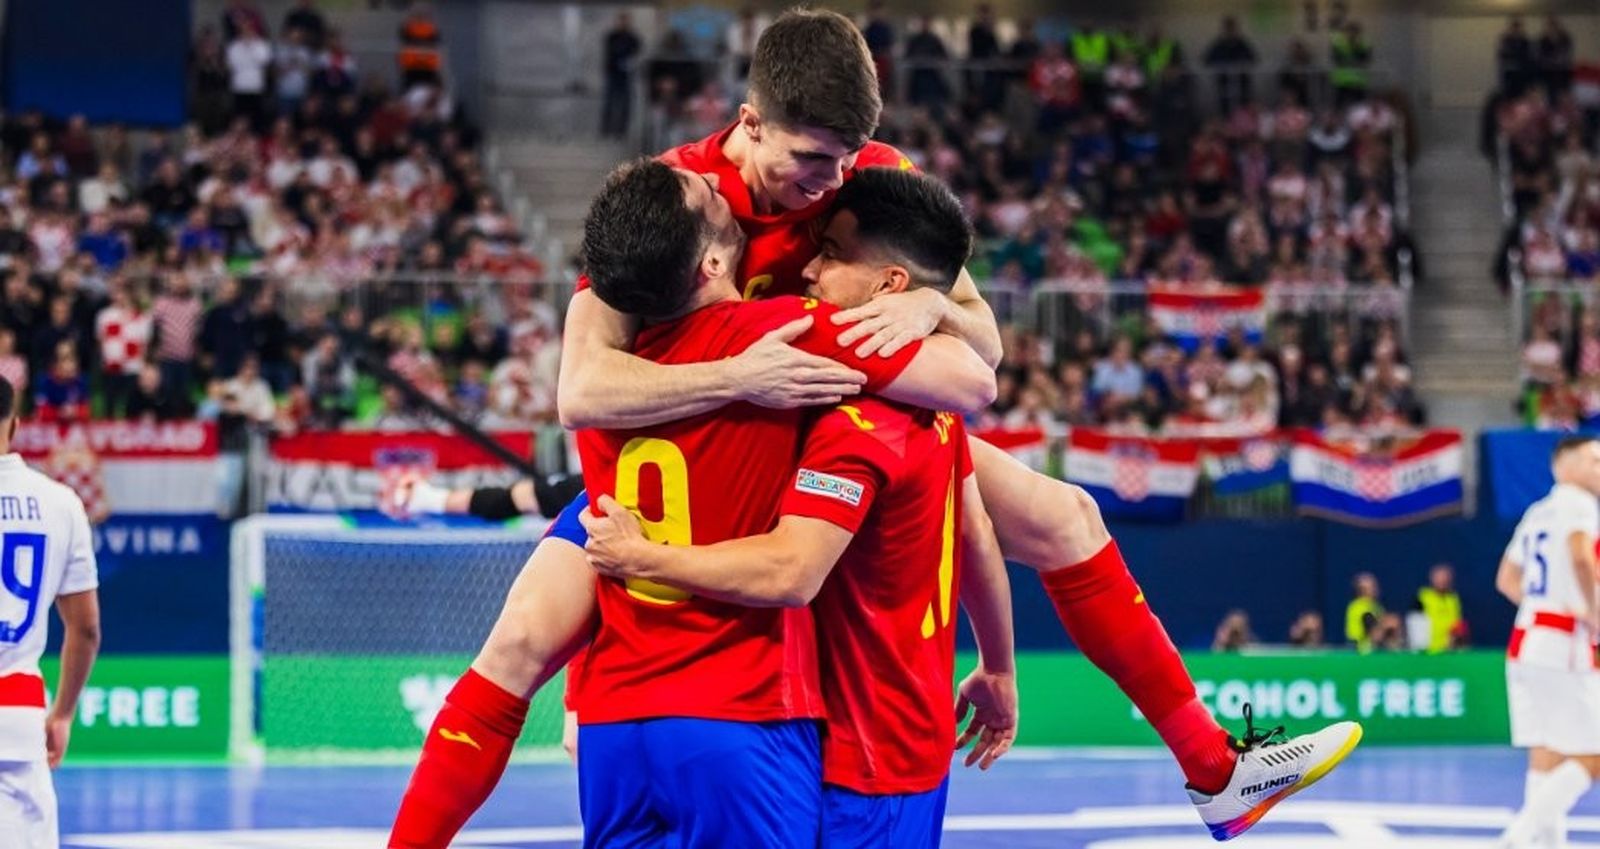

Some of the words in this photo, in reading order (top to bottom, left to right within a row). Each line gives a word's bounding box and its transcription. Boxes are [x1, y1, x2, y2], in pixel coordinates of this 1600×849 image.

[797, 474, 862, 498] FOUNDATION
[614, 436, 692, 605] 9
[79, 686, 201, 728] FREE
[1131, 679, 1346, 720] COHOL
[1357, 679, 1466, 718] FREE
